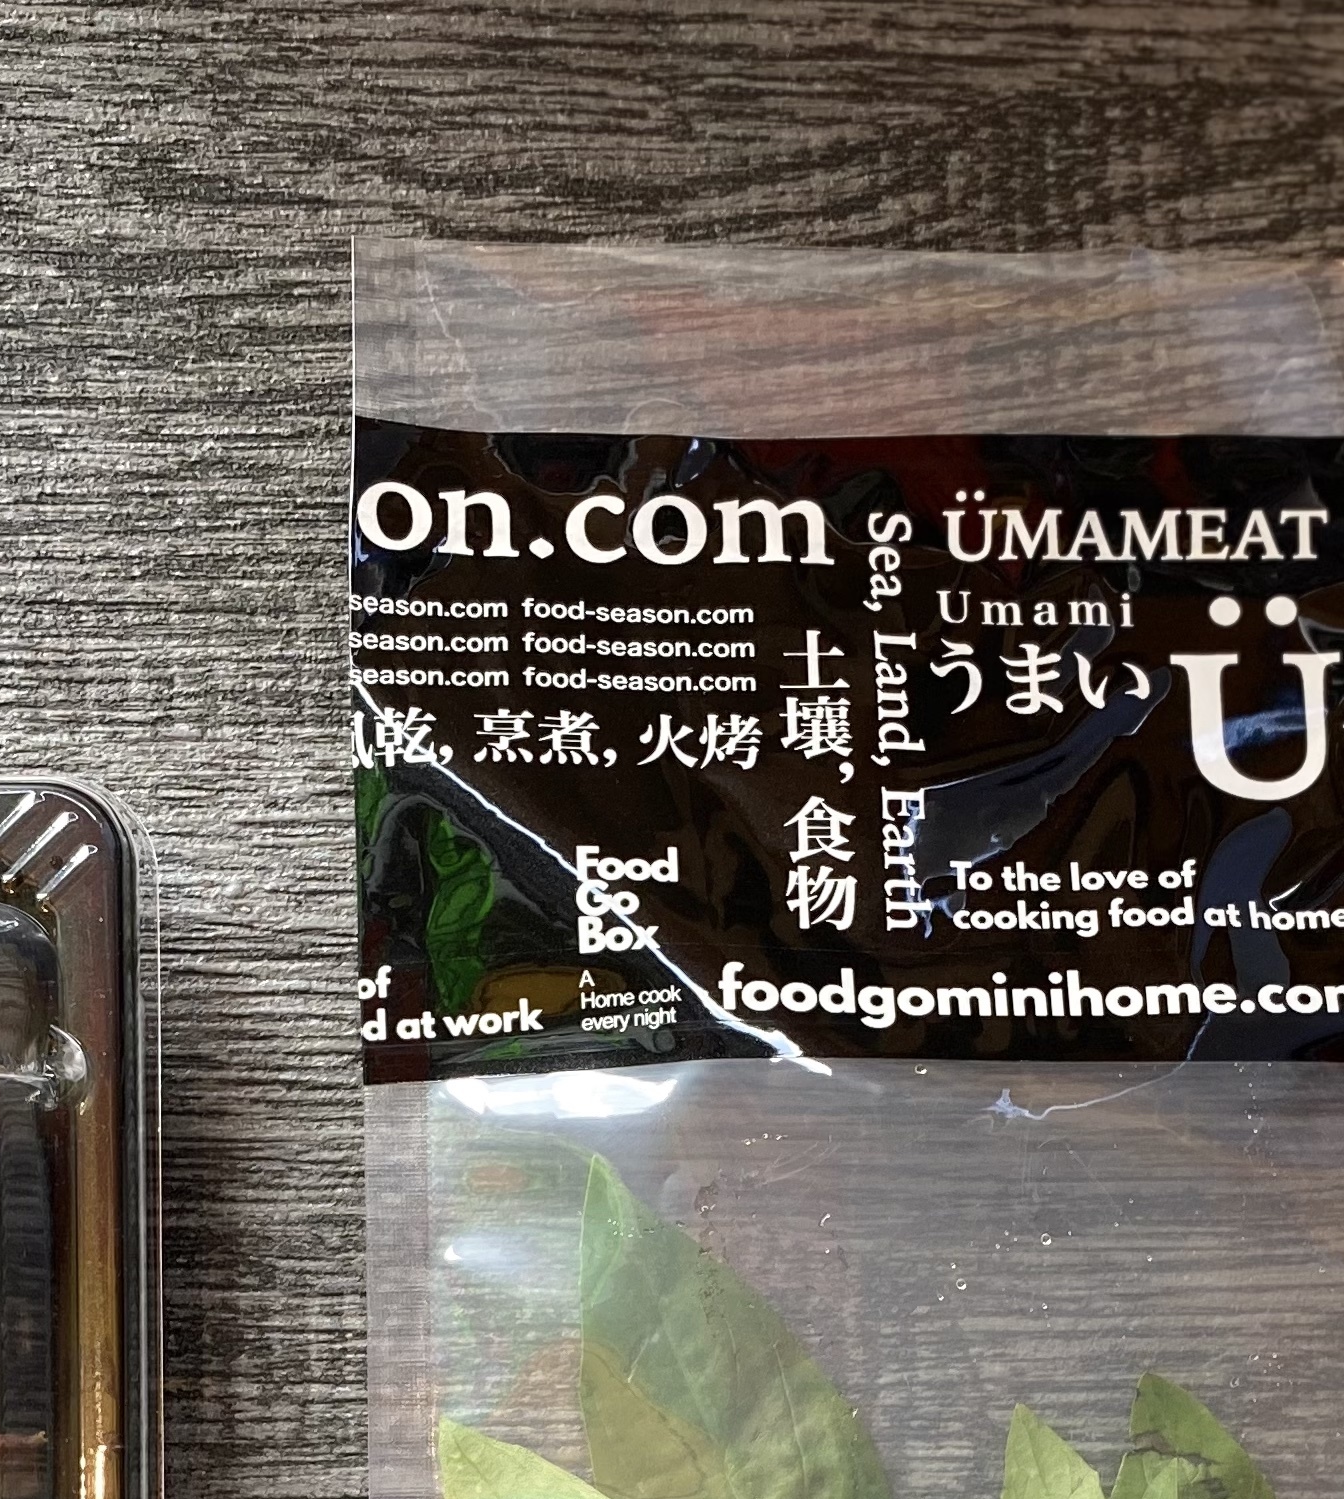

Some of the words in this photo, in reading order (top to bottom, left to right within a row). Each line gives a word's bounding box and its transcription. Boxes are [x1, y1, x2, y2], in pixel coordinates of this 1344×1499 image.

[357, 481, 835, 566] on.com
[942, 490, 1328, 562] ÜMAMEAT
[862, 512, 912, 612] Sea,
[521, 597, 754, 625] food-season.com
[936, 590, 1133, 627] Umami
[521, 631, 755, 658] food-season.com
[522, 666, 757, 692] food-season.com
[929, 638, 1150, 715] うまい
[778, 629, 855, 784] 土壤,
[870, 630, 926, 767] Land,
[1169, 596, 1341, 801] Ü
[473, 708, 617, 768] 烹煮,
[637, 713, 764, 770] 火烤
[576, 845, 679, 883] Food
[783, 795, 858, 931] 食物
[881, 786, 933, 931] Earth
[950, 862, 993, 892] To
[1000, 861, 1061, 892] the
[1070, 861, 1149, 891] love
[1157, 859, 1196, 889] of
[575, 879, 641, 916] Go
[952, 901, 1099, 938] cooking
[1108, 895, 1195, 928] food
[1203, 903, 1241, 929] at
[578, 919, 660, 954] Box
[578, 969, 596, 988] A
[580, 991, 635, 1010] Home
[638, 984, 682, 1005] cook
[396, 1011, 437, 1040] at
[442, 997, 544, 1037] work
[581, 1013, 631, 1033] every
[633, 1006, 678, 1030] night
